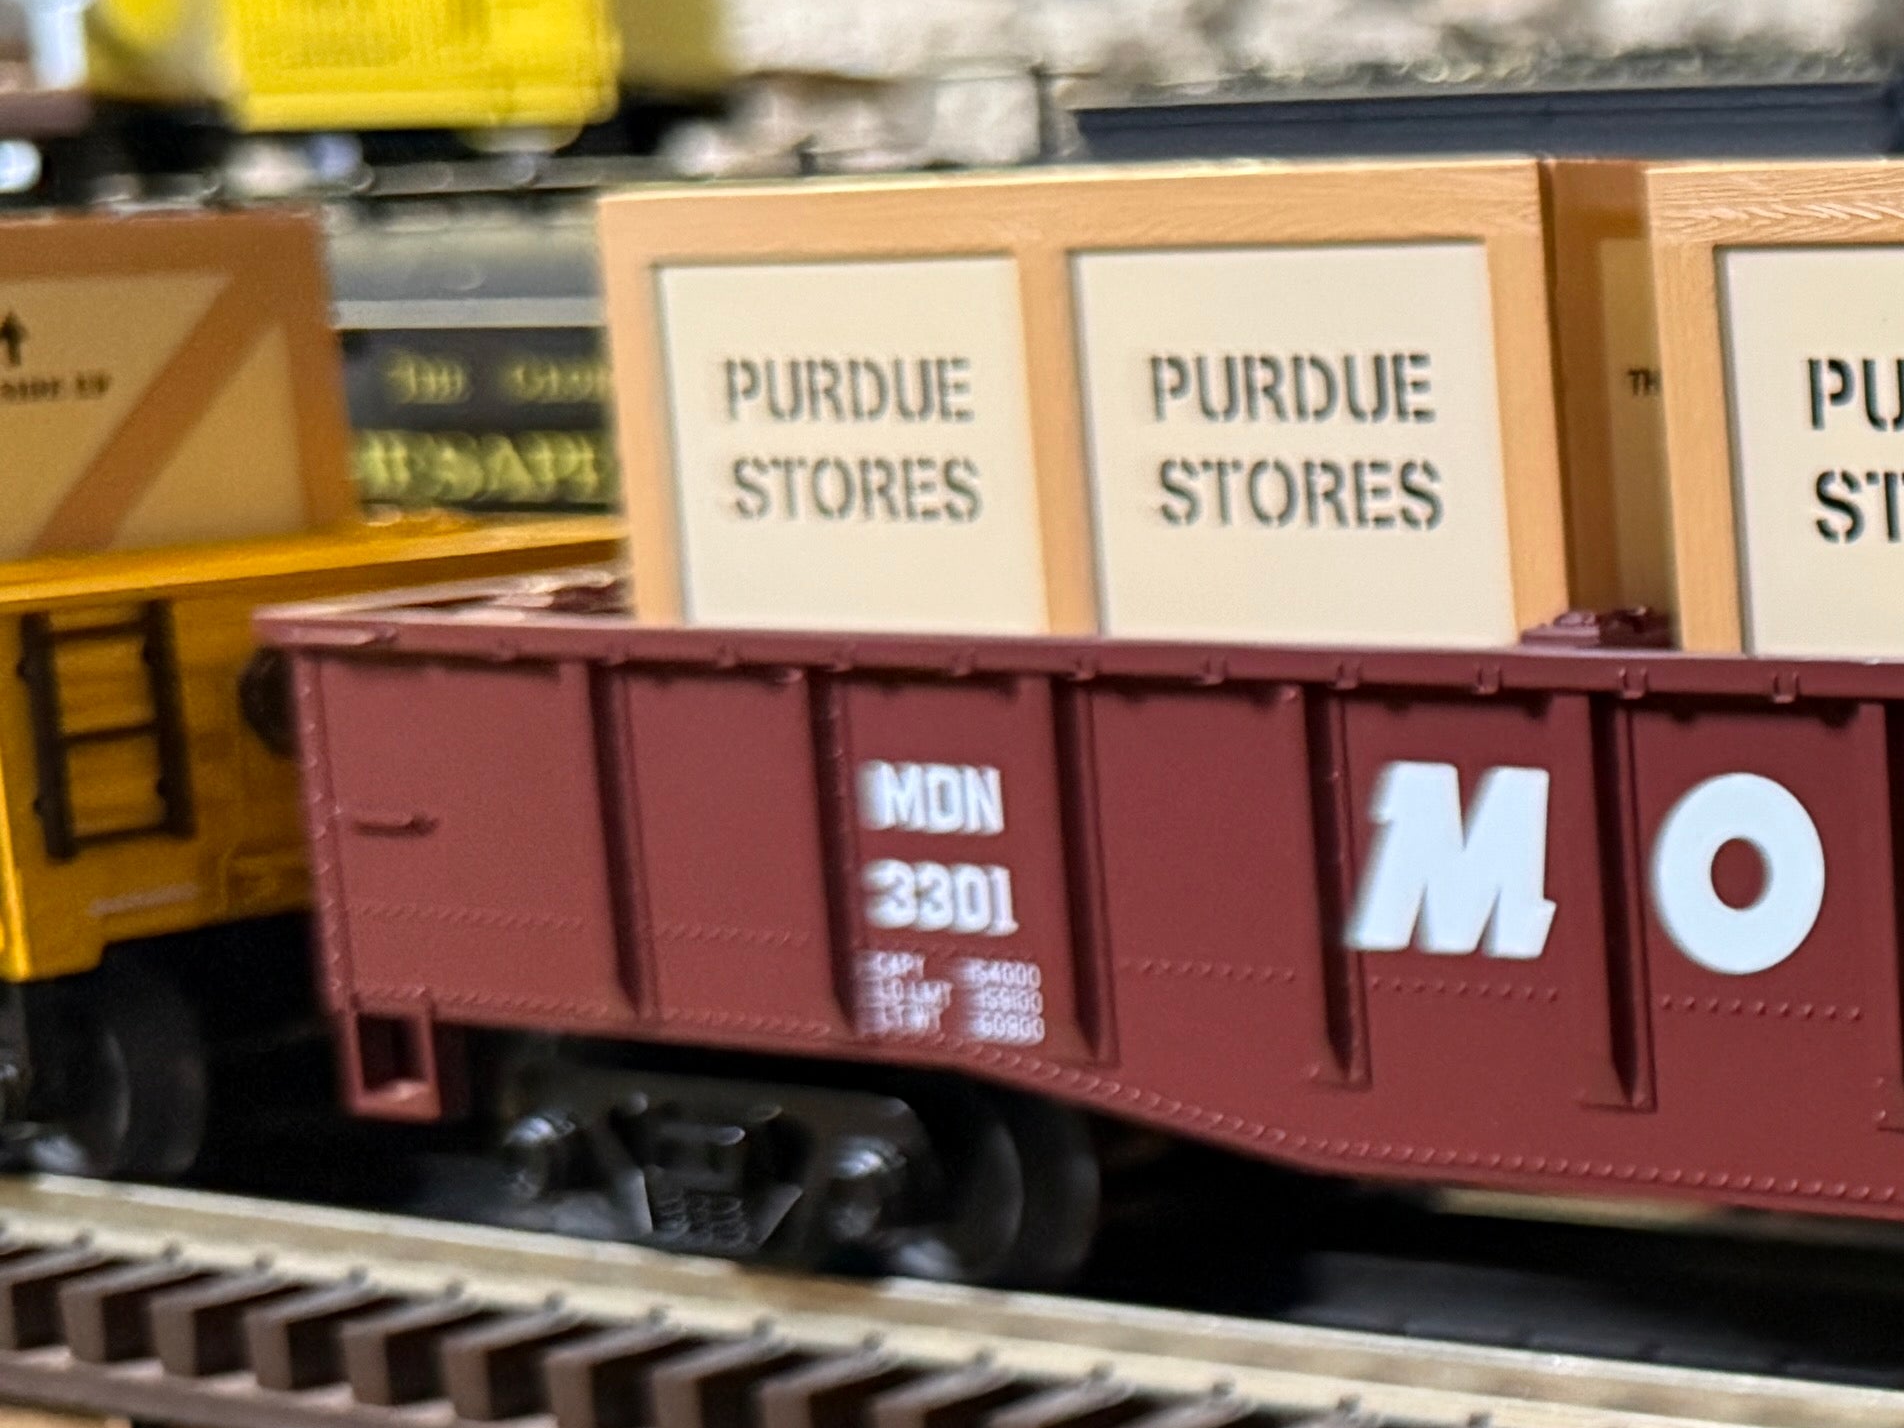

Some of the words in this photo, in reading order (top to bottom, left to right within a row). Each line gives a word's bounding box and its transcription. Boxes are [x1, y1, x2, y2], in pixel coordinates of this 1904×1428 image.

[725, 358, 970, 421] PURDUE
[1150, 353, 1434, 422] PURDUE
[733, 457, 978, 520] STORES
[1159, 458, 1442, 529] STORES
[860, 761, 1005, 835] MON
[864, 859, 1019, 936] 3301
